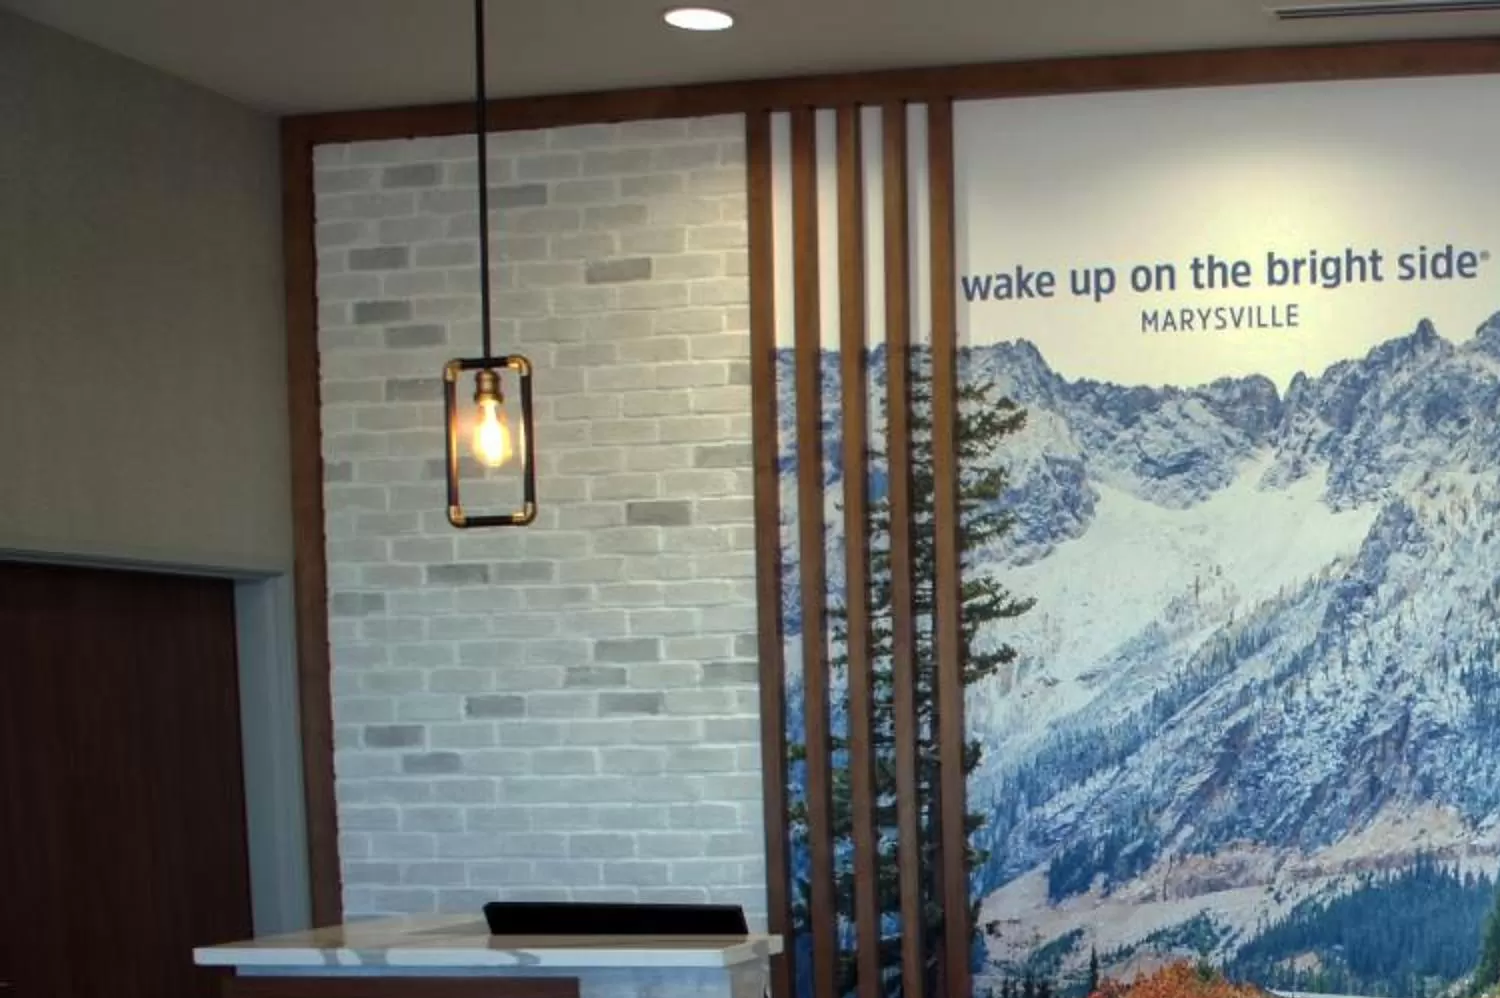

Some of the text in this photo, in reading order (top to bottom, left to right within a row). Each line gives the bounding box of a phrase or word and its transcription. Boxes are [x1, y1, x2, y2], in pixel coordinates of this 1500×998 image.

[962, 265, 1055, 302] wake
[1070, 267, 1116, 302] up
[1131, 263, 1176, 292] on
[1190, 254, 1251, 289] the
[1267, 248, 1383, 288] bright
[1141, 304, 1299, 332] MARYSVILLE
